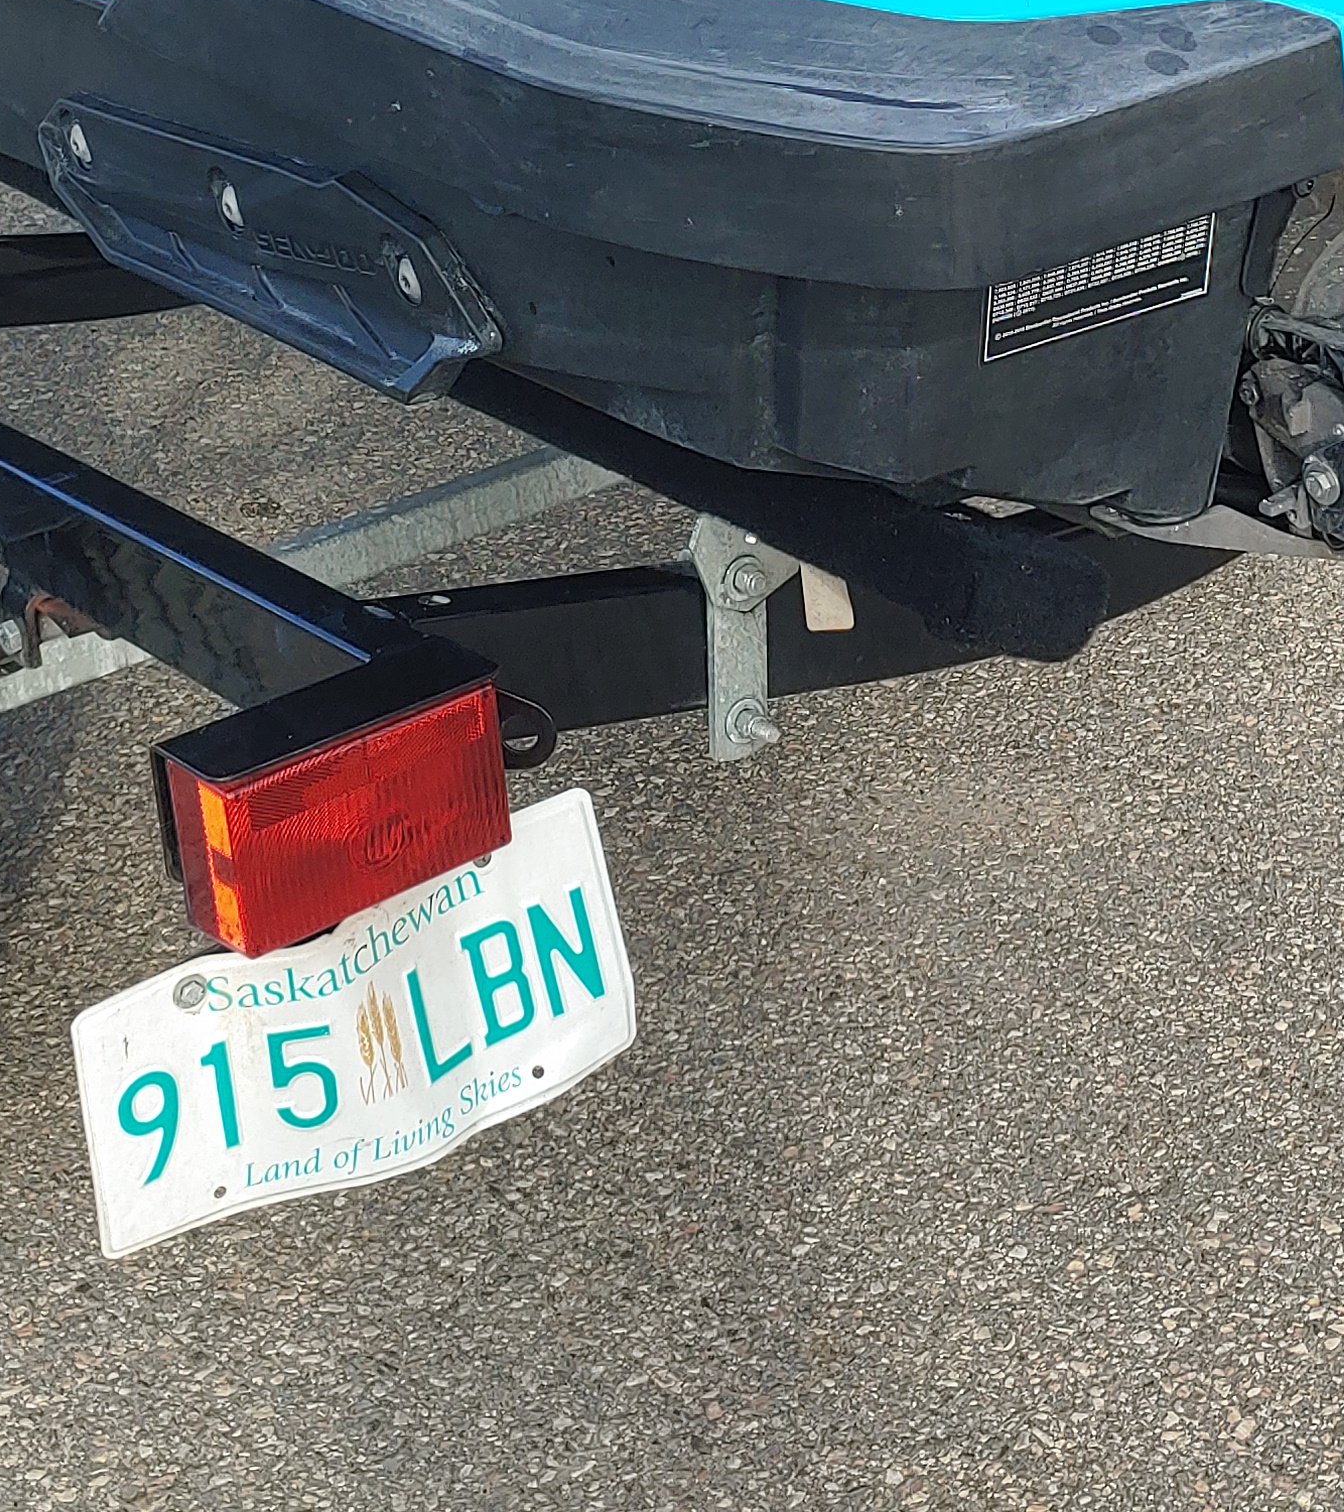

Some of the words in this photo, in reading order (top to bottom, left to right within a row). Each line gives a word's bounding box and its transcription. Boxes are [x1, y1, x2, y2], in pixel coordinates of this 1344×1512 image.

[207, 868, 485, 1013] Saskatchewan
[117, 1024, 340, 1187] 915
[406, 887, 606, 1085] LBN
[244, 1154, 322, 1188] Land
[331, 1140, 365, 1176] of
[372, 1108, 456, 1163] Living
[460, 1064, 523, 1116] Skies
